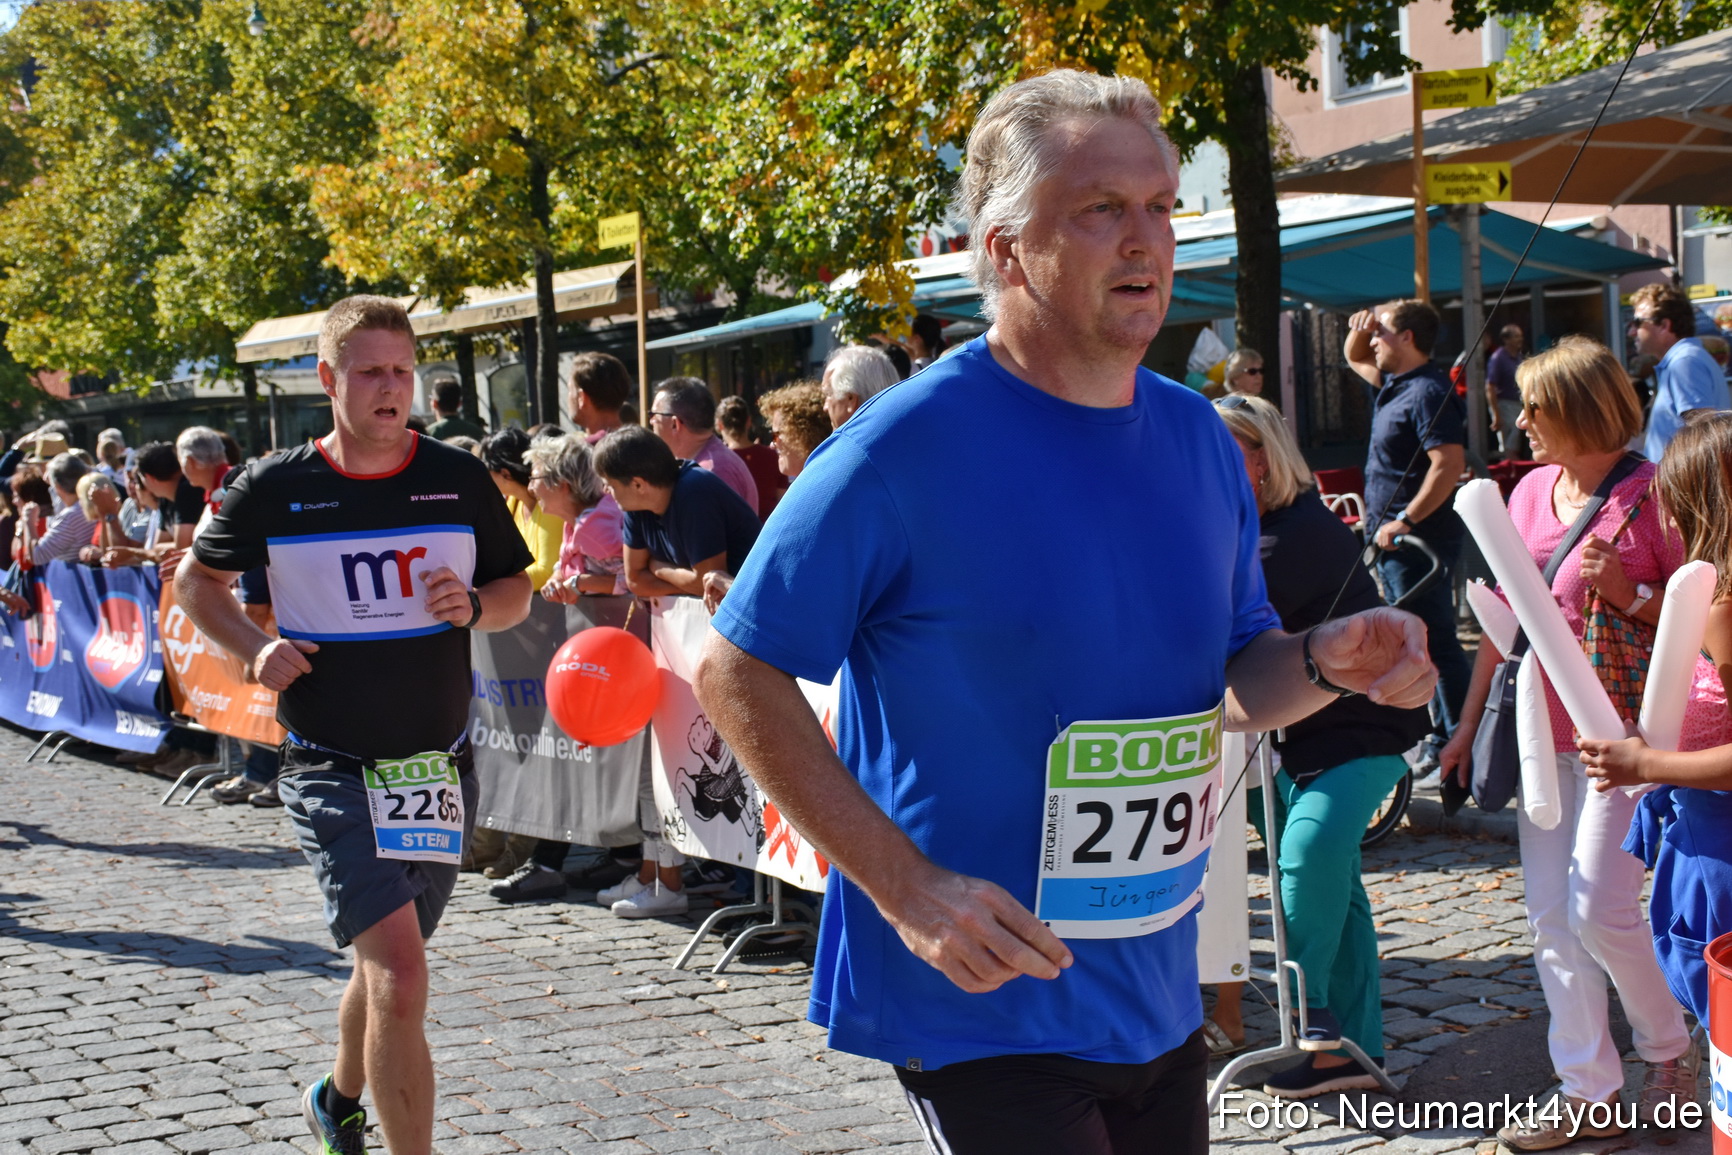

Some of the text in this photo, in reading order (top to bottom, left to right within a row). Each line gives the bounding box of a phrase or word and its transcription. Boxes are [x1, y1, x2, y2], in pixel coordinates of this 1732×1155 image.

[1422, 75, 1482, 90] tartnummern-
[420, 493, 459, 501] ILLSCHWANG
[340, 546, 428, 601] mr
[1067, 722, 1222, 780] BOCK
[376, 756, 454, 785] BOC
[1072, 782, 1213, 864] 2791
[401, 832, 450, 849] STEFAN
